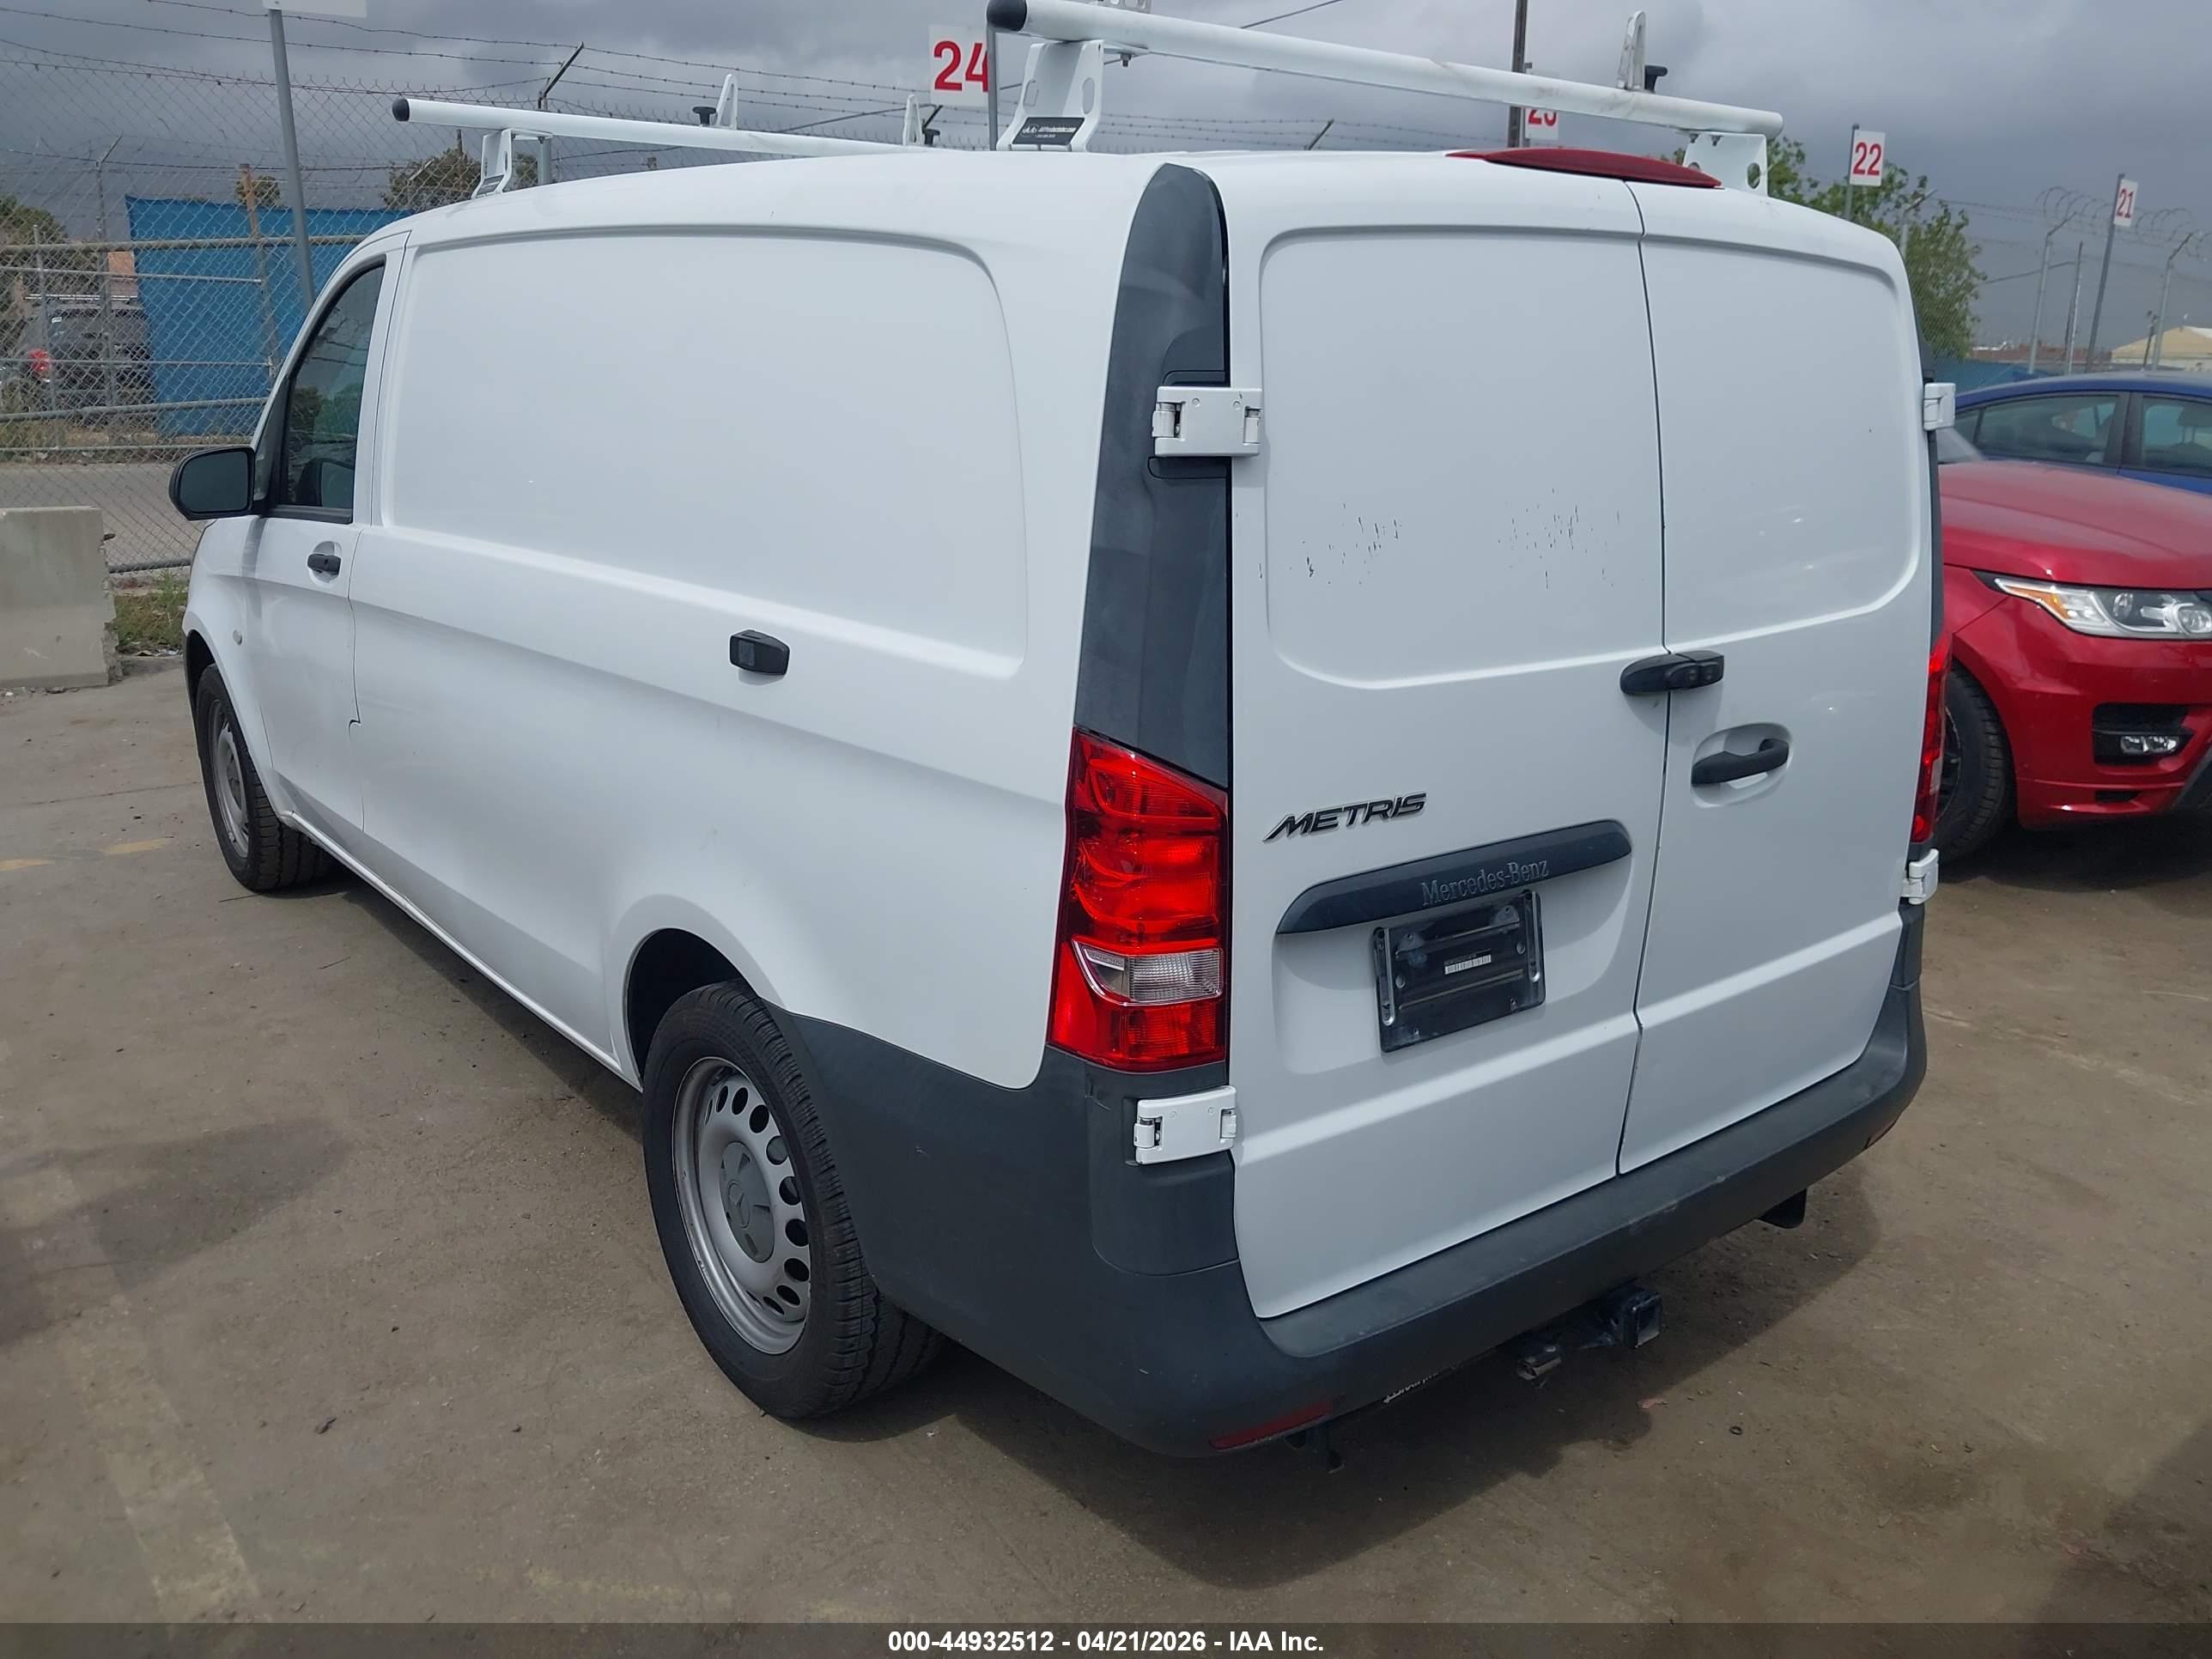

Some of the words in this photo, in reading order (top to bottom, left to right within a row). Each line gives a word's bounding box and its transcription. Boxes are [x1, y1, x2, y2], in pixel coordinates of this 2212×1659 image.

[933, 40, 988, 93] 24
[1853, 142, 1881, 176] 22
[2116, 188, 2134, 218] 21
[1262, 793, 1427, 842] METRIS
[1420, 860, 1550, 907] Mercedes-Benz
